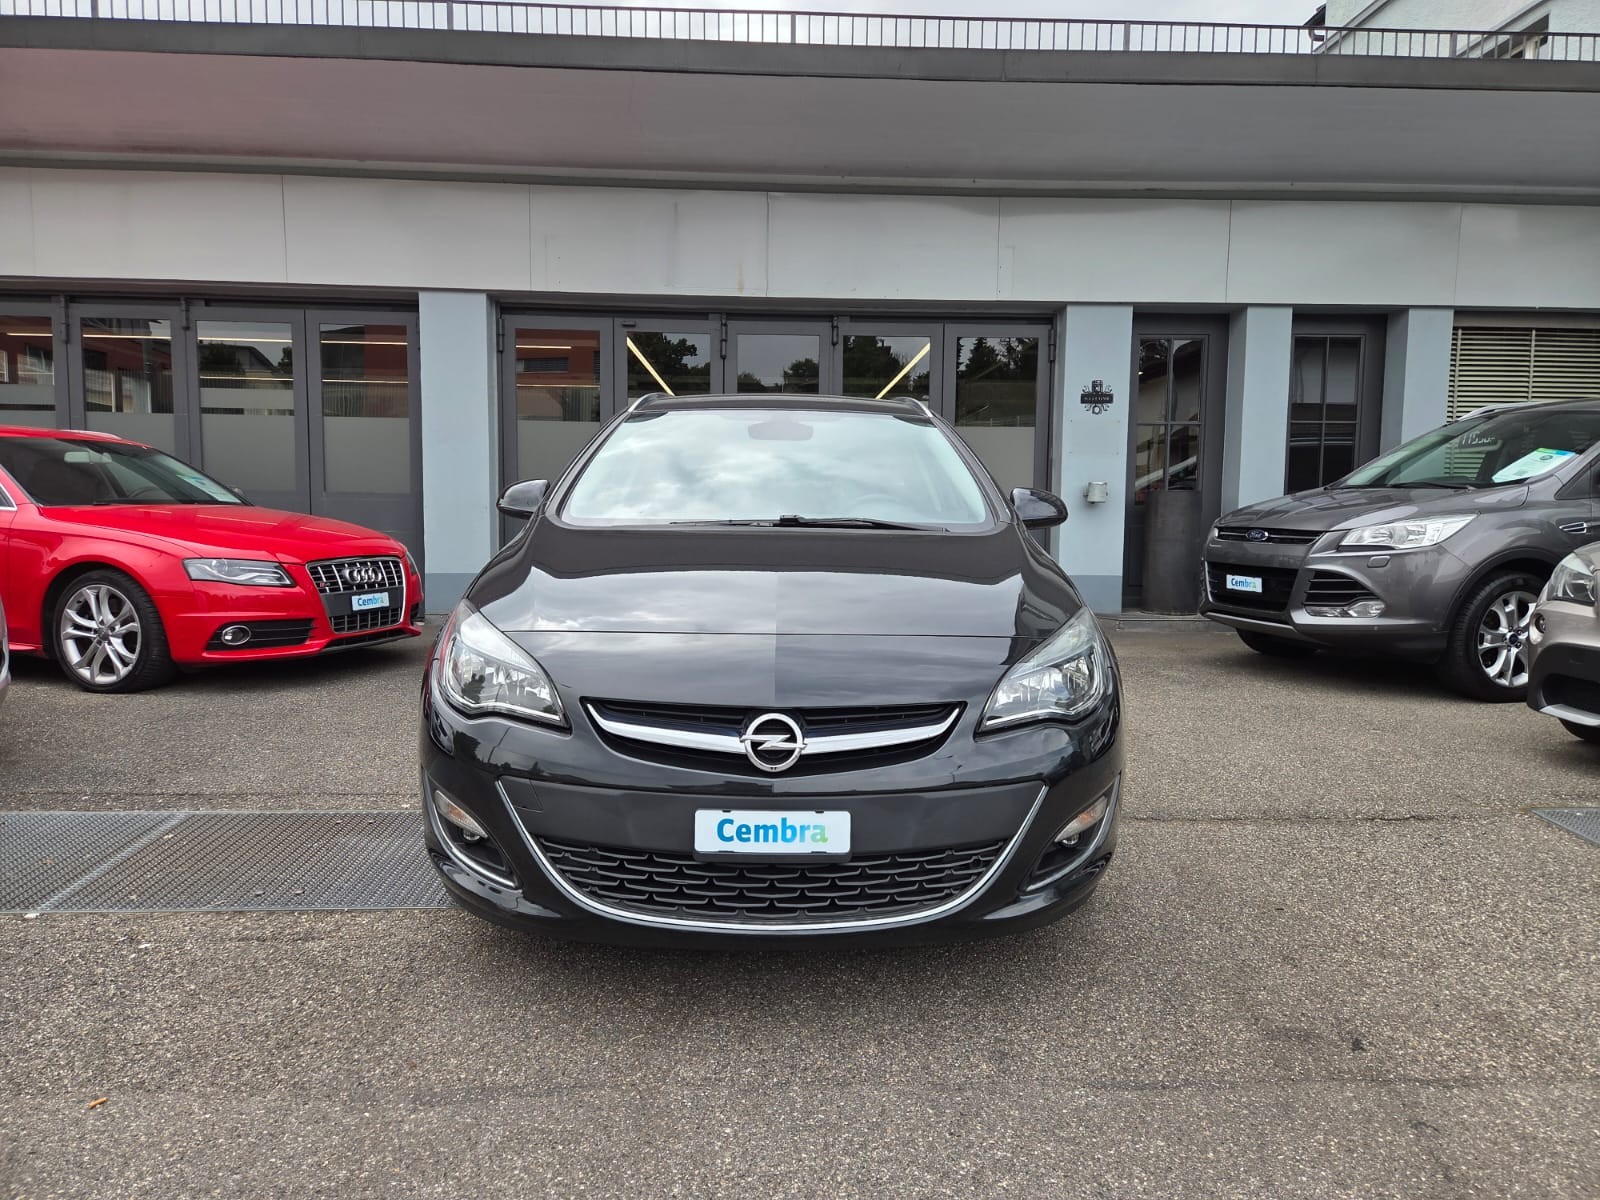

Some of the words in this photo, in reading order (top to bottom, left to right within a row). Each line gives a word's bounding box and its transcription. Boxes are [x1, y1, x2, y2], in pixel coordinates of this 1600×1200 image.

[1231, 577, 1257, 589] Cembra
[357, 595, 385, 607] Cembra
[717, 817, 829, 843] Cembra
